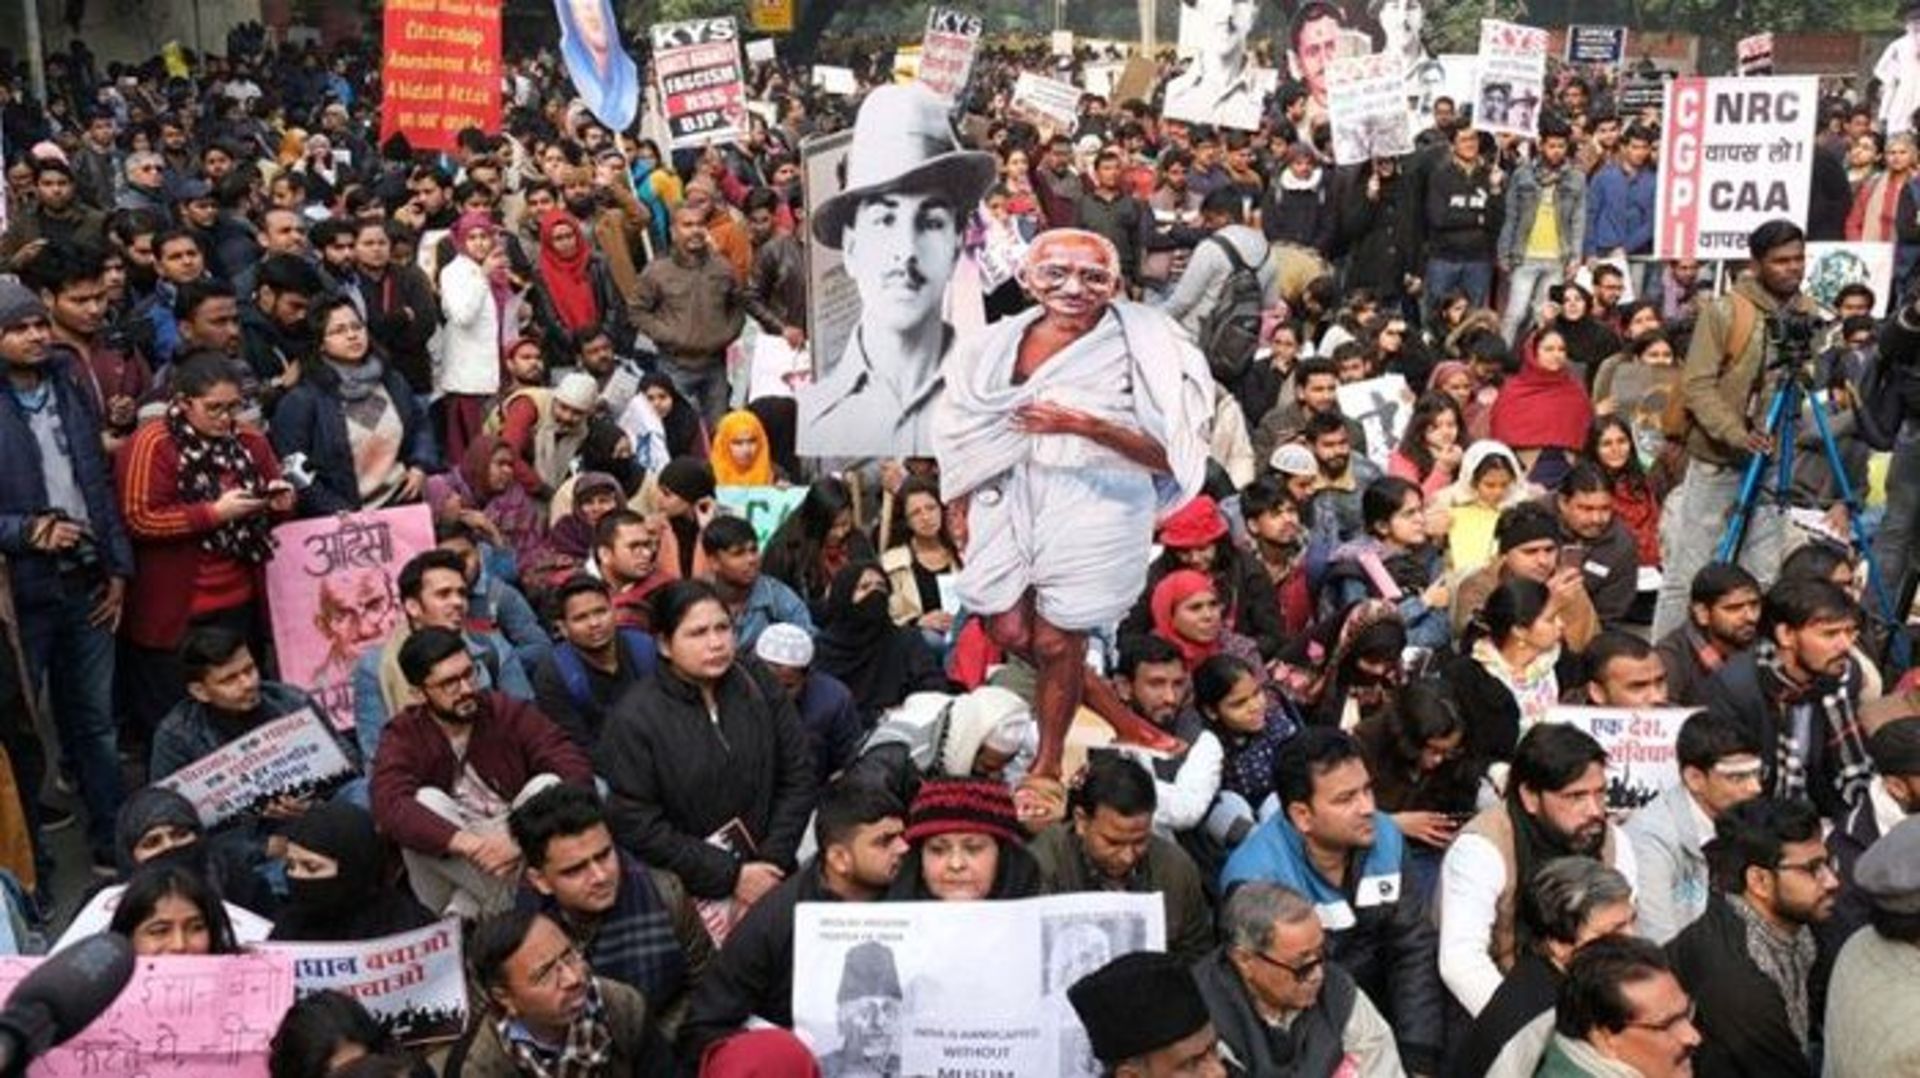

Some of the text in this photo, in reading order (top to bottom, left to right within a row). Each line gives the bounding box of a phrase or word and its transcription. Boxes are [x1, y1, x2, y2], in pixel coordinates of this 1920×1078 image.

[654, 18, 736, 50] KYS
[665, 66, 735, 93] FASCISM
[1715, 92, 1800, 124] NRC
[679, 111, 719, 133] BJP
[1705, 142, 1762, 164] वापस
[1671, 89, 1700, 259] CGPI
[1709, 180, 1790, 212] CAA
[1591, 718, 1624, 738] एक
[943, 1046, 1011, 1059] WITHOUT
